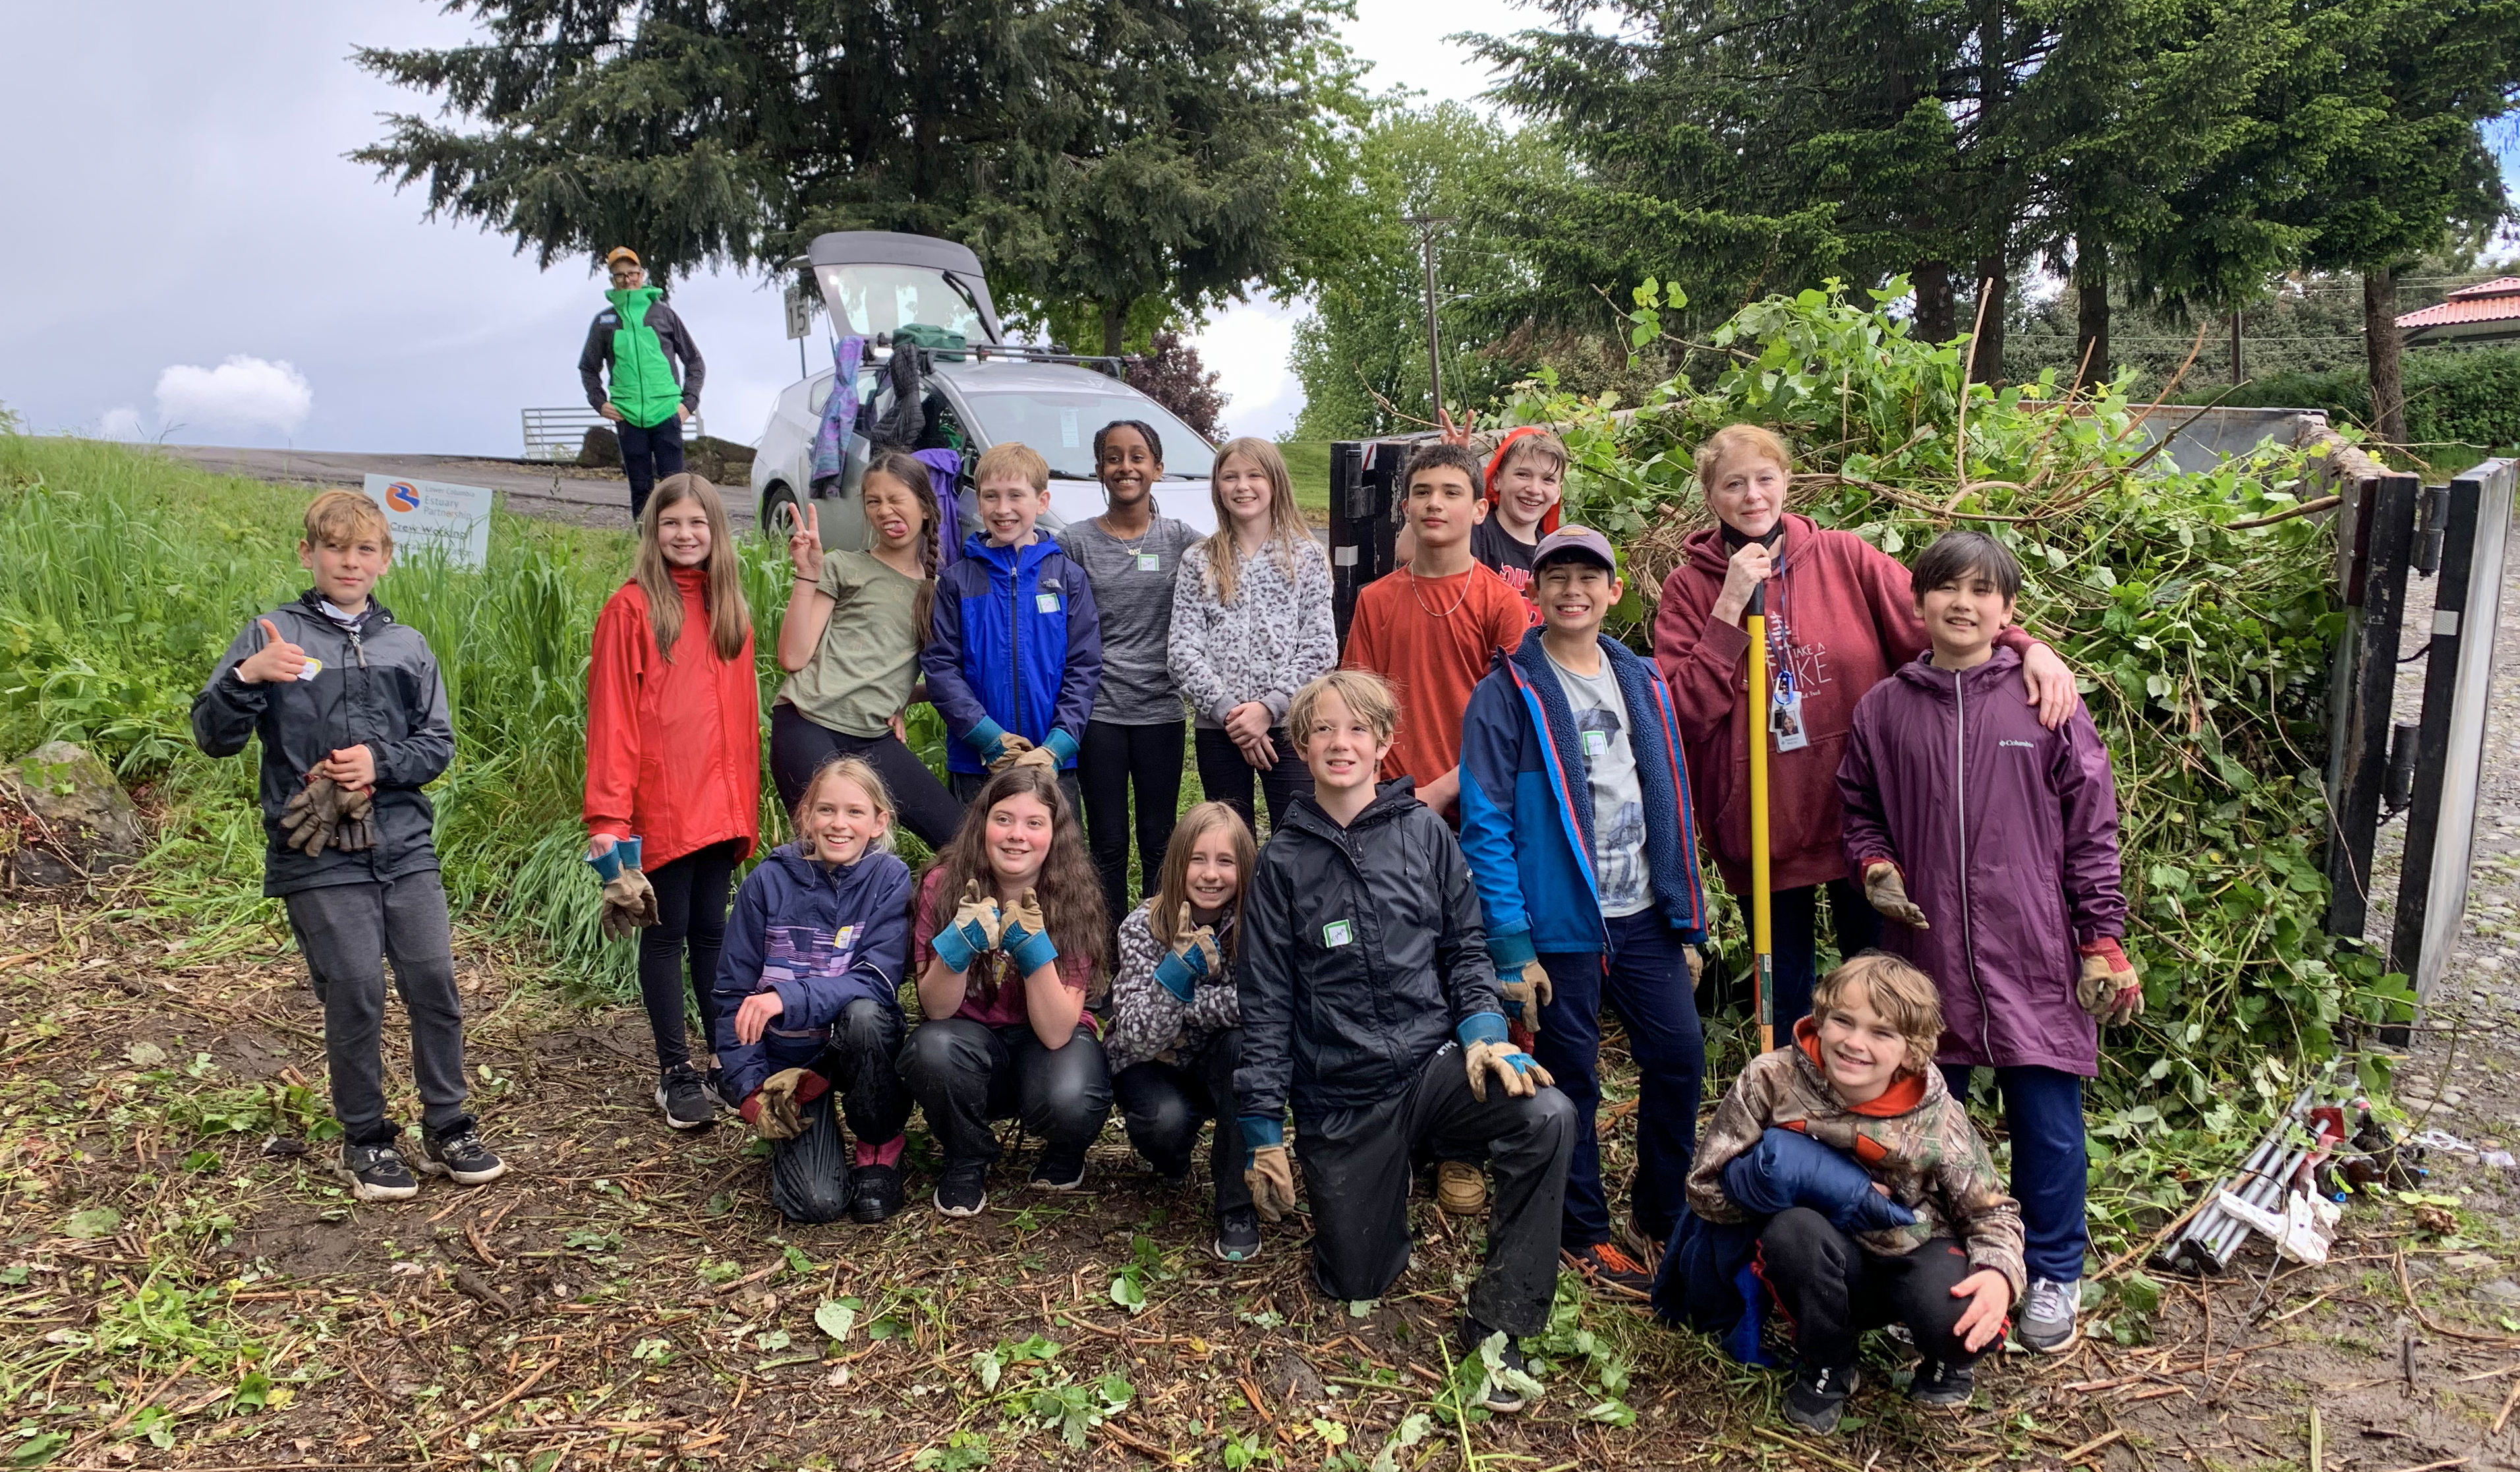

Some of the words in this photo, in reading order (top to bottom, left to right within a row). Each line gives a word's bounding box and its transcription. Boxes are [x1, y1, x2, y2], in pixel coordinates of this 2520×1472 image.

[789, 304, 807, 333] 15
[425, 485, 445, 494] Lower
[446, 487, 475, 498] Columbia
[424, 495, 459, 510] Estuary
[424, 506, 472, 521] Partnership
[390, 521, 416, 533] Crew
[1792, 643, 1814, 659] TAKE
[1818, 641, 1825, 651] A
